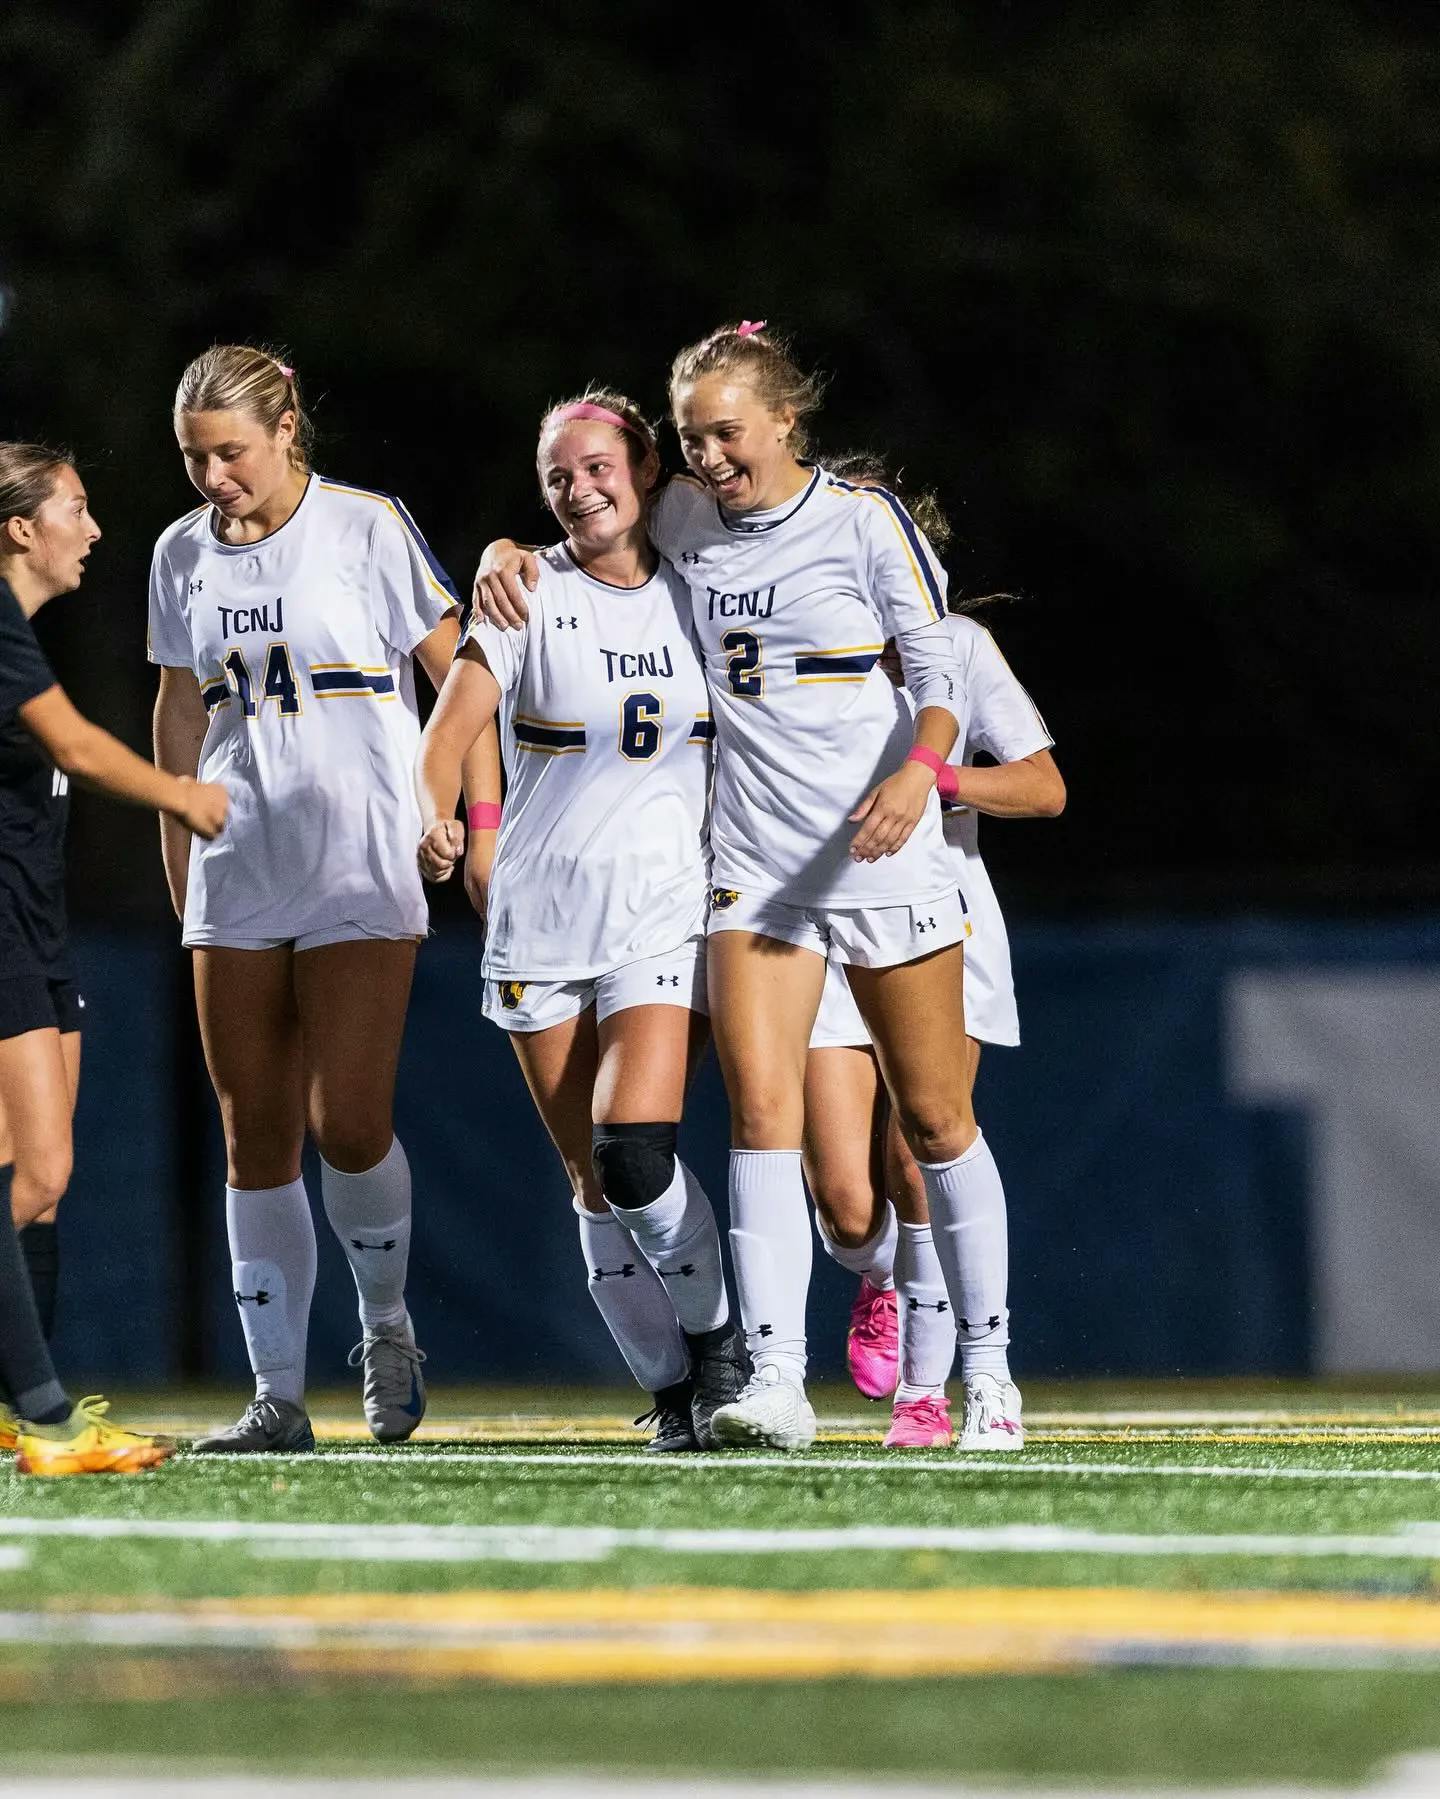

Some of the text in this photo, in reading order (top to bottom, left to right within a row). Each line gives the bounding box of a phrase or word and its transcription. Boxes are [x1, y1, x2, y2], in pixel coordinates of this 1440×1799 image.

[217, 597, 284, 640] TCNJ
[706, 585, 776, 620] TCNJ
[222, 642, 302, 720] 14
[600, 645, 674, 683] TCNJ
[720, 628, 766, 699] 2
[618, 690, 664, 762] 6
